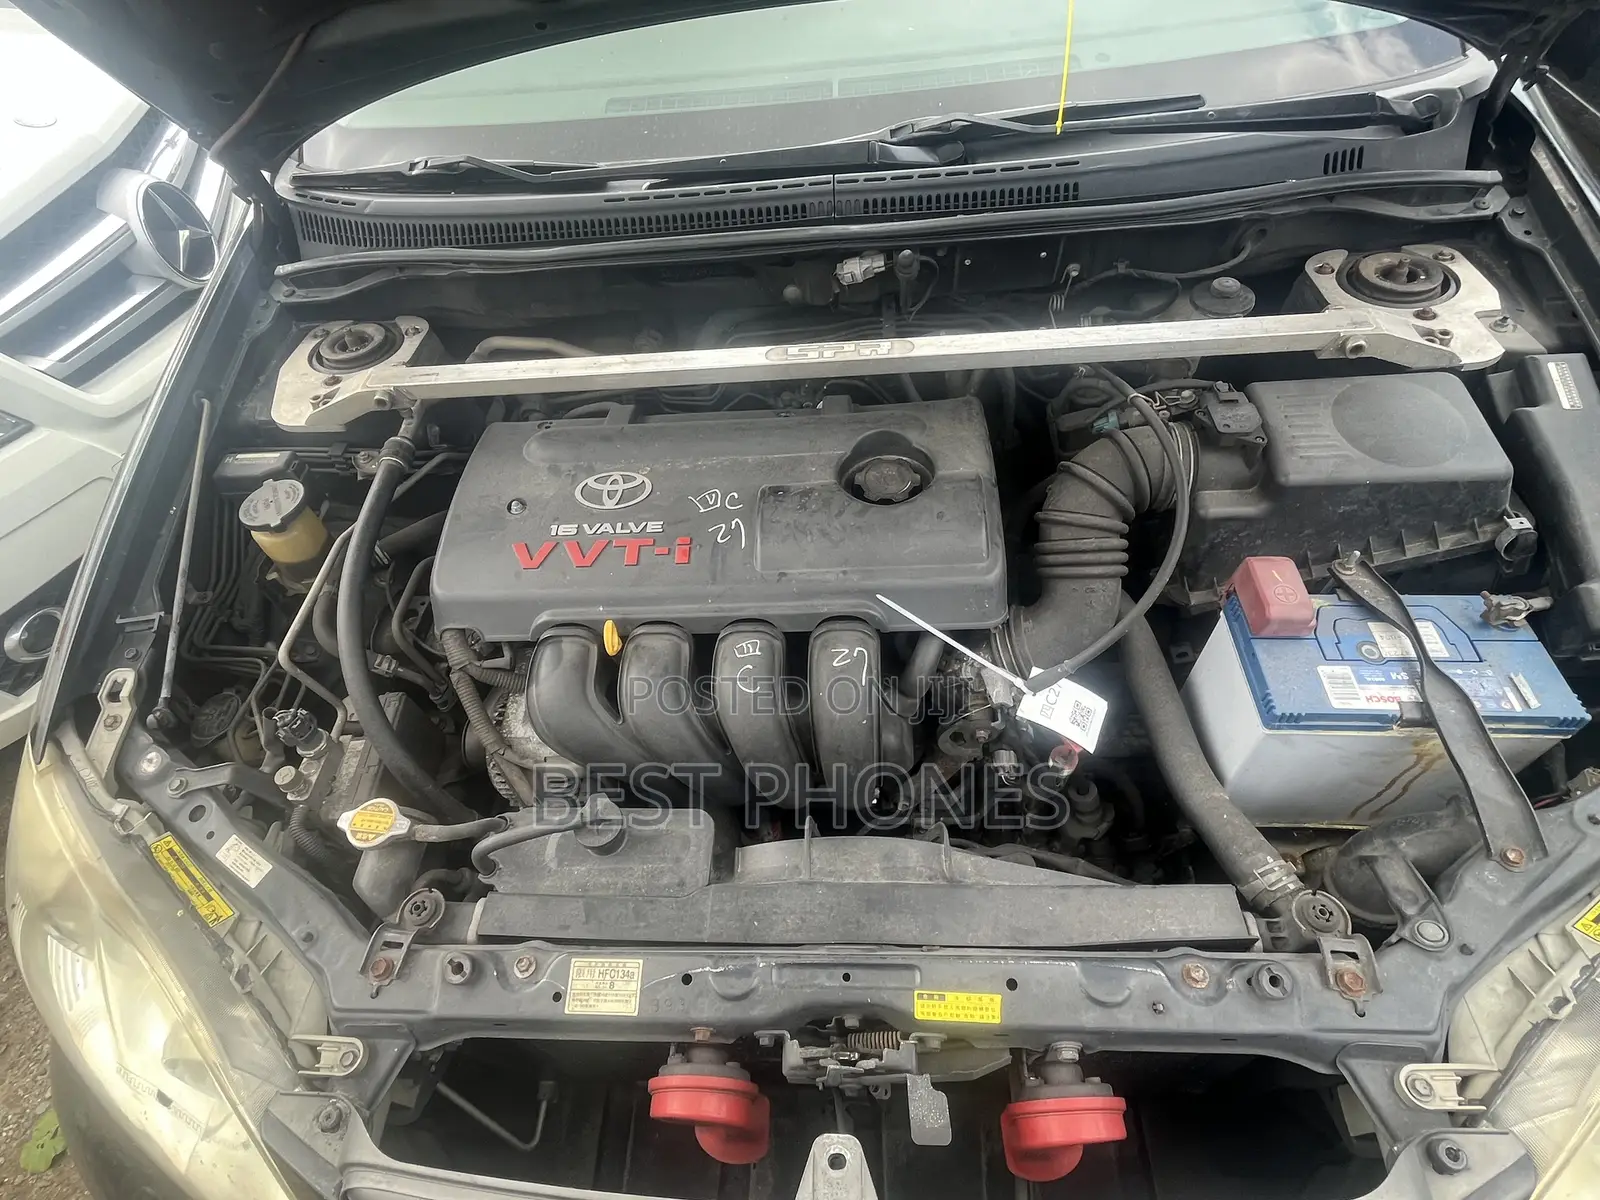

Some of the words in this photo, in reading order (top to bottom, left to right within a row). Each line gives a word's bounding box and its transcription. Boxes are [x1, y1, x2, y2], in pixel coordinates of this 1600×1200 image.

[786, 341, 892, 360] SPR
[550, 523, 579, 536] 16
[582, 521, 665, 535] VALVE
[511, 536, 694, 570] VVT-i
